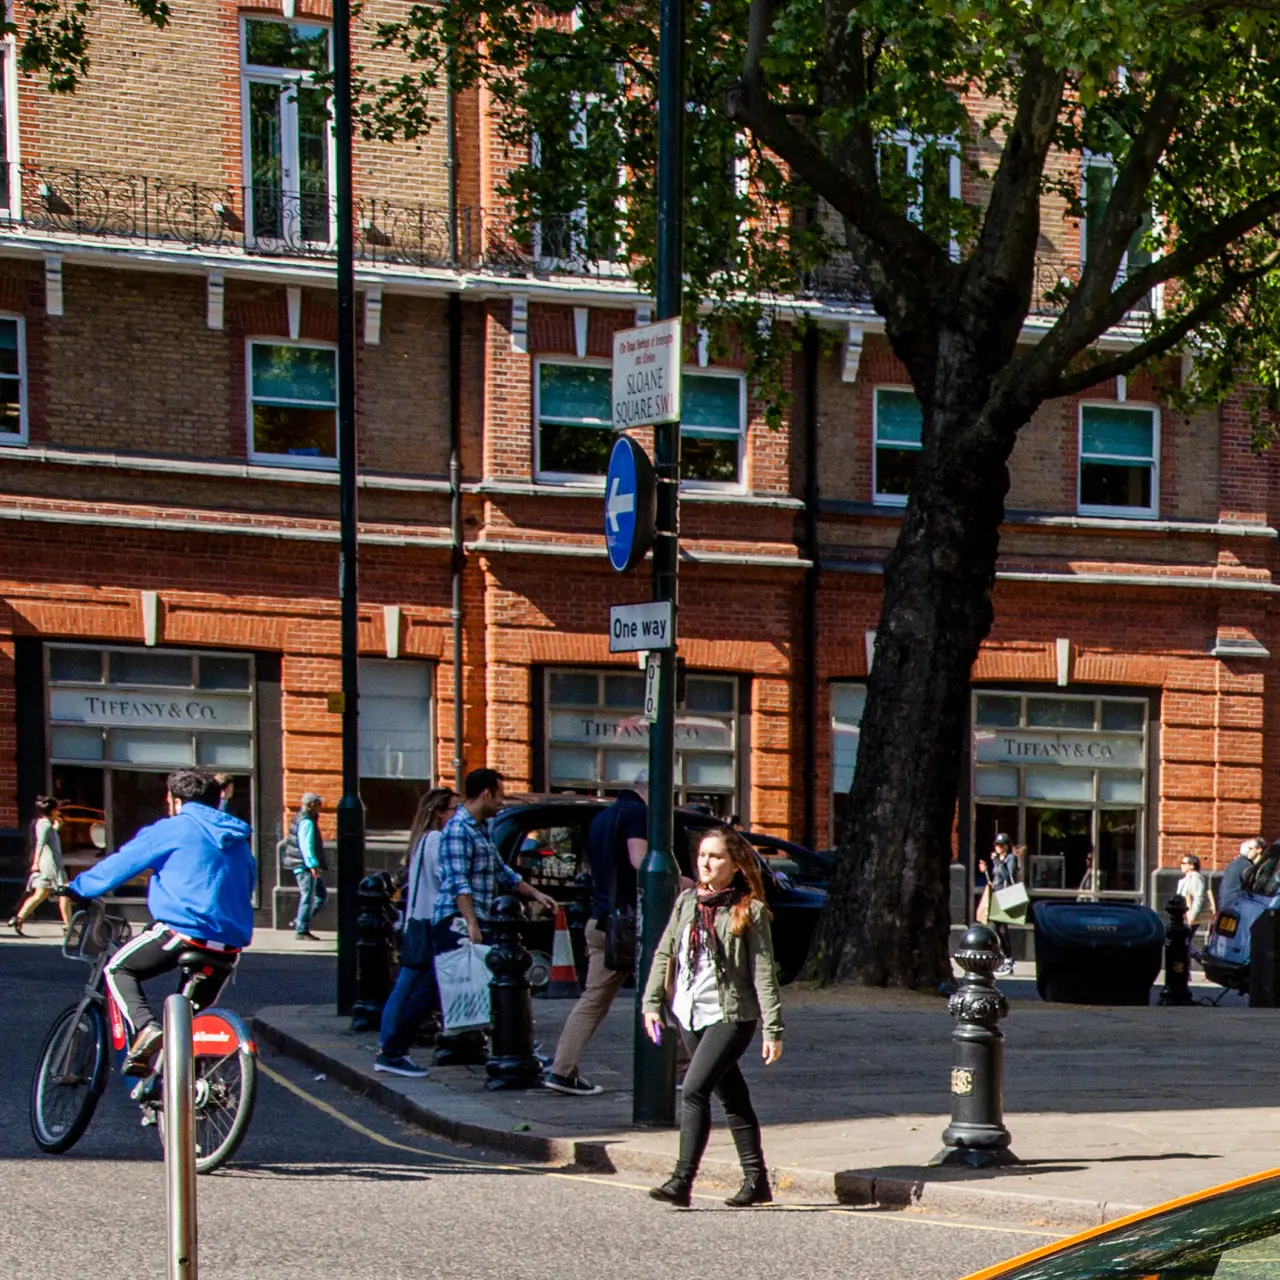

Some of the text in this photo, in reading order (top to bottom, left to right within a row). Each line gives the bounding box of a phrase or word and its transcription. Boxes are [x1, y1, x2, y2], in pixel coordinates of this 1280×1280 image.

[627, 367, 663, 395] SLOANE
[613, 618, 667, 639] One way
[84, 697, 165, 717] TIFFANY
[581, 719, 650, 738] TIFFAN
[1003, 738, 1071, 757] TIFFANY
